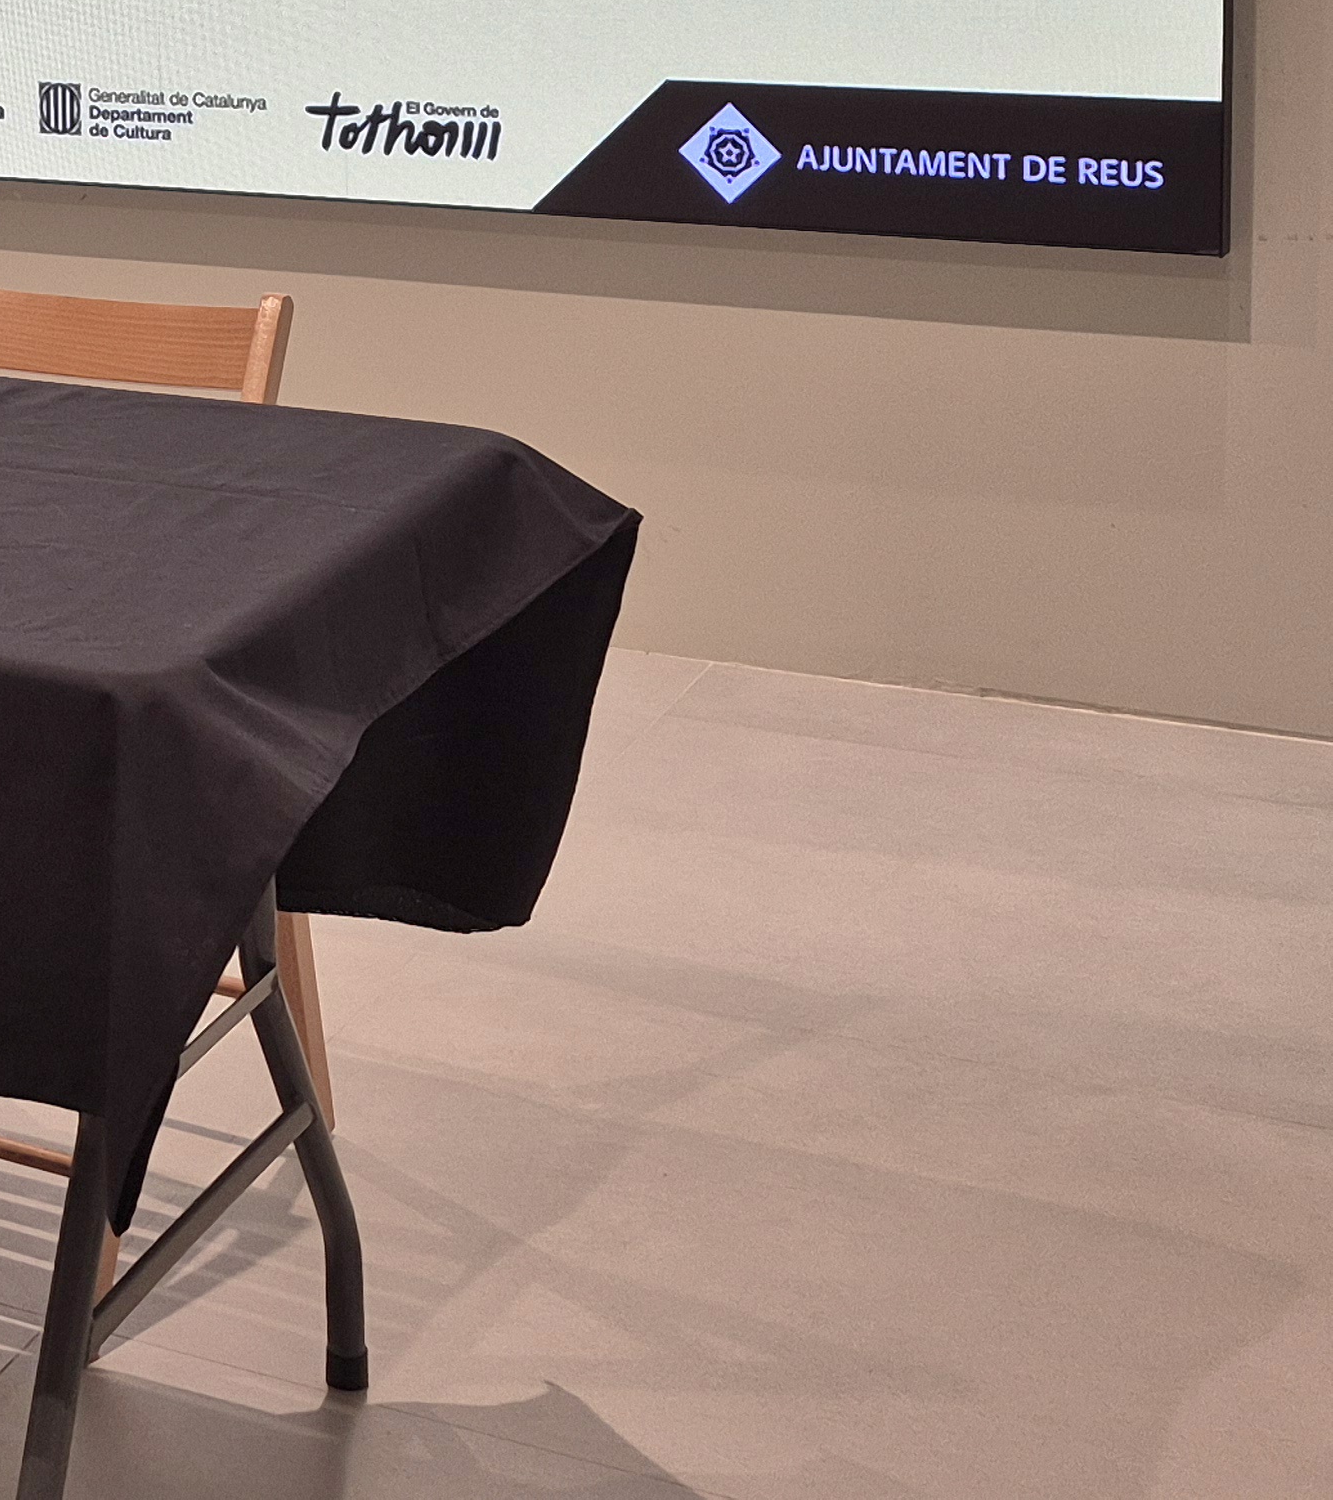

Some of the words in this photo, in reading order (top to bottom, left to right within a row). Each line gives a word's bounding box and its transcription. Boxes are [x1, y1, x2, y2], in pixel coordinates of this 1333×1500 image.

[88, 88, 165, 106] Generalitat
[169, 92, 188, 107] de
[193, 92, 267, 113] Catalunya
[406, 102, 420, 114] El
[424, 102, 476, 117] Govern
[480, 104, 499, 118] de
[89, 105, 193, 124] Departament
[89, 123, 108, 137] de
[113, 124, 172, 140] Cultura
[796, 144, 1011, 182] AJUNTAMENT
[1023, 154, 1066, 185] DE
[1078, 156, 1165, 189] REUS
